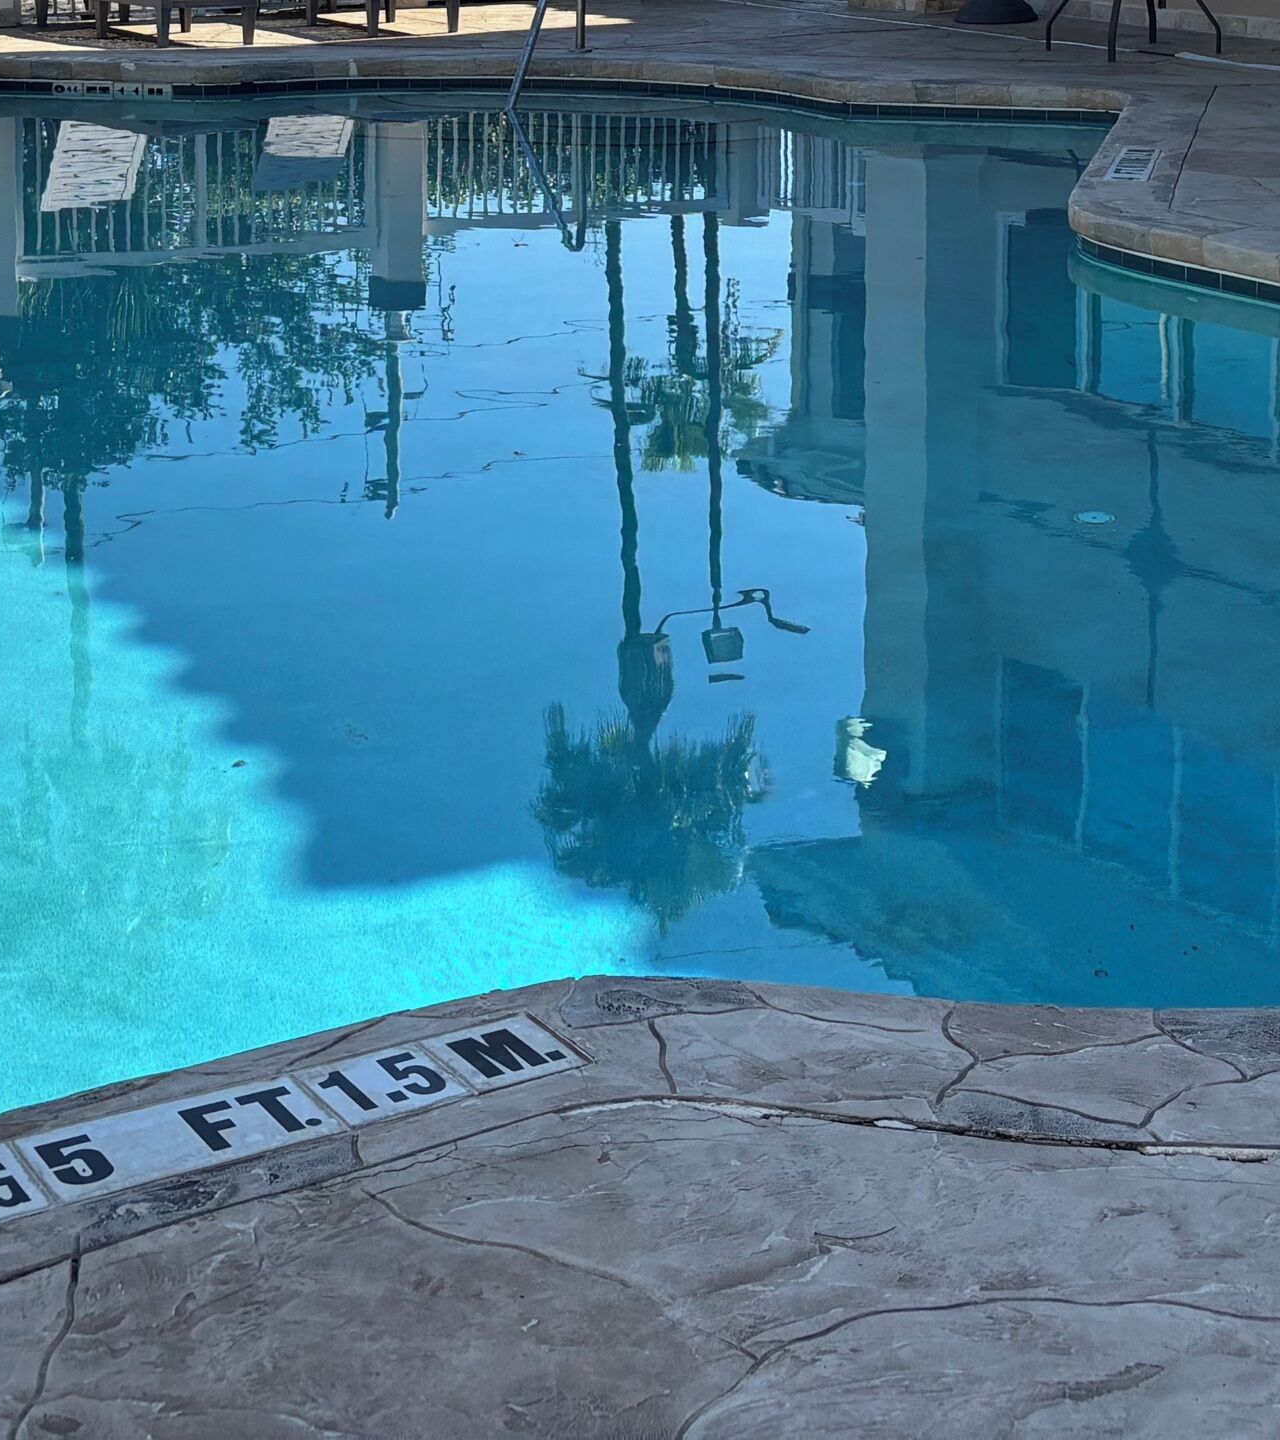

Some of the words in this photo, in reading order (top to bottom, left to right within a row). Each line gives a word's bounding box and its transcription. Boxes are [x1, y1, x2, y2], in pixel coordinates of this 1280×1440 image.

[34, 1134, 115, 1185] 5
[178, 1086, 321, 1151] FT.
[318, 1052, 446, 1111] 1.5
[446, 1028, 566, 1078] M.
